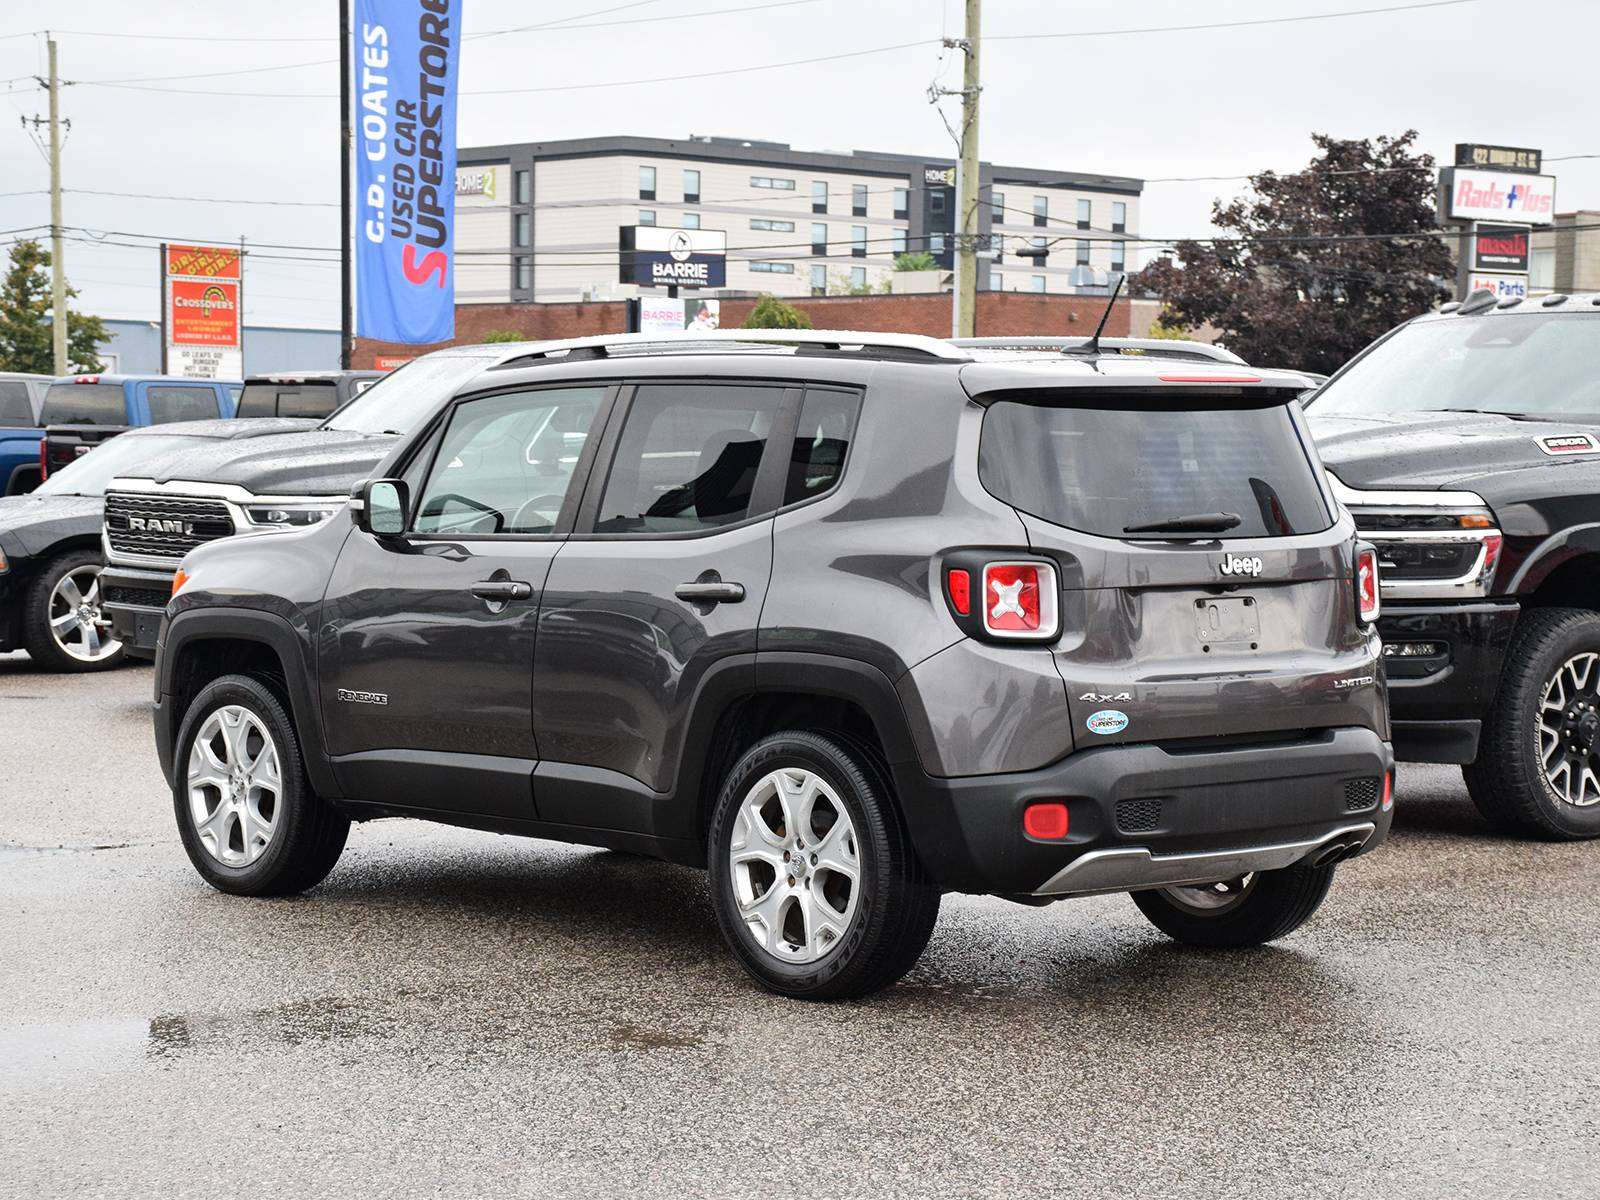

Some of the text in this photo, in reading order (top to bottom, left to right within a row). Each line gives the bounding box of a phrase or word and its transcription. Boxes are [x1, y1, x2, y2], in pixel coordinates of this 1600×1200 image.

[362, 23, 388, 244] G.D. COATES
[391, 99, 416, 239] USED CAR
[1456, 179, 1552, 213] Rads Plus
[652, 262, 708, 278] BARRIE
[1499, 281, 1524, 297] Parts
[643, 310, 683, 322] BARRIE
[128, 516, 183, 534] RAM
[1220, 553, 1263, 577] Jeep
[337, 688, 388, 705] RENEGADE
